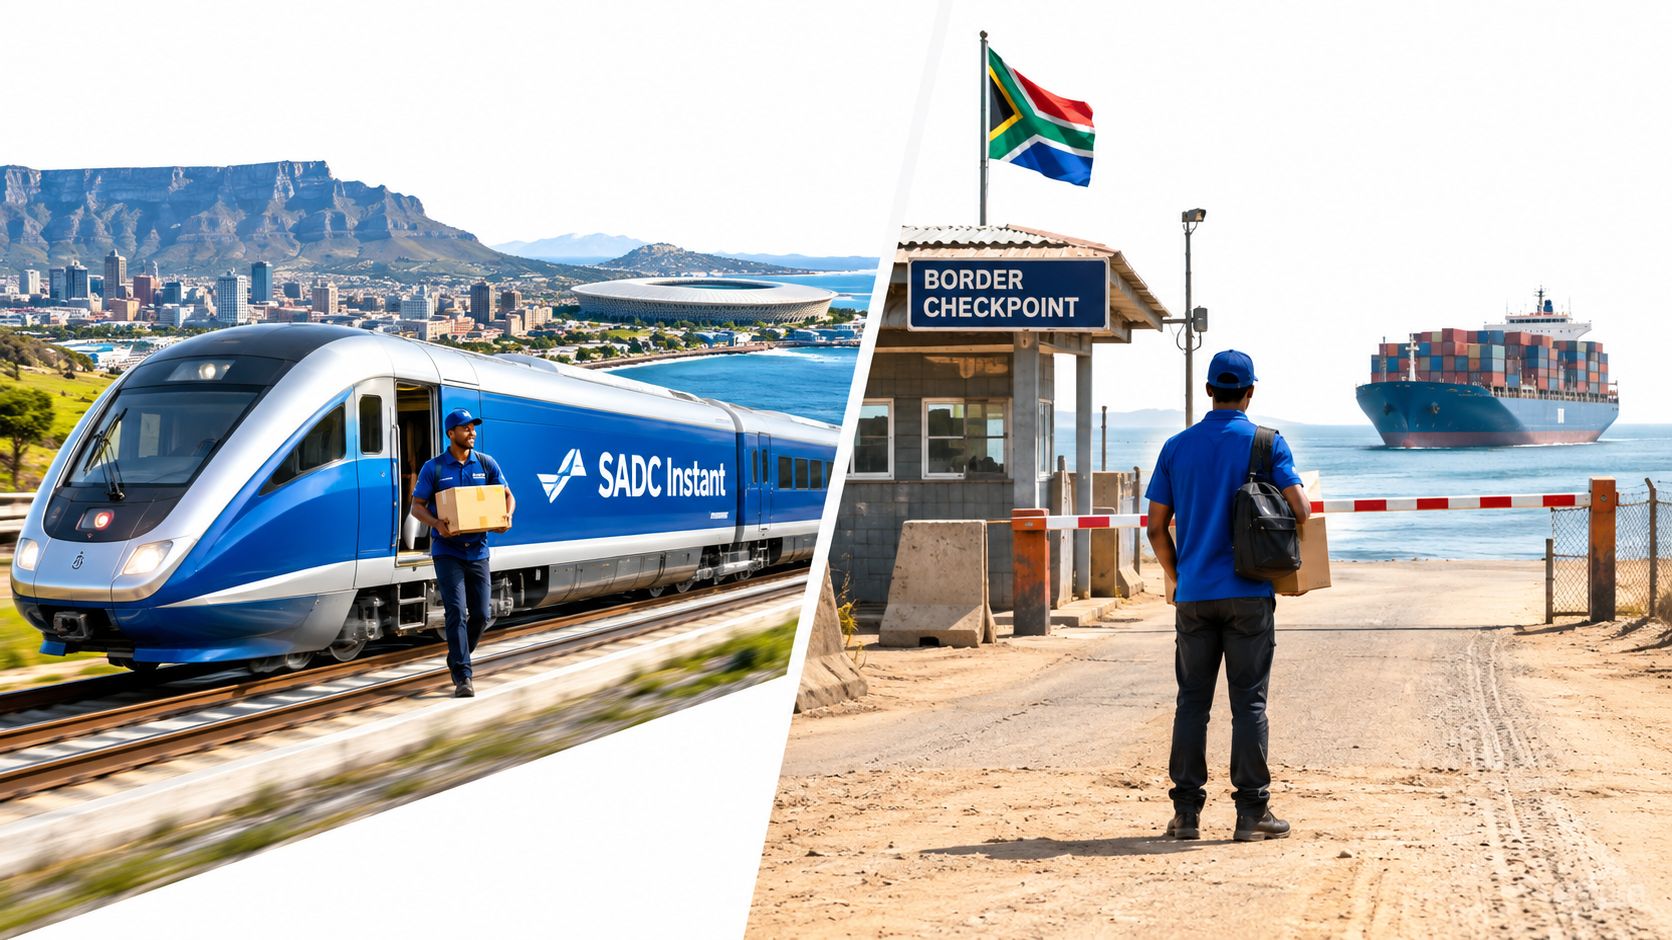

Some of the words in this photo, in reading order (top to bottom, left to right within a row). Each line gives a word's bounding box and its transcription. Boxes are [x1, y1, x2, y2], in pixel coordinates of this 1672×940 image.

[924, 269, 1024, 290] BORDER
[923, 296, 1080, 318] CHECKPOINT
[598, 451, 662, 499] SADC
[666, 456, 726, 497] Instant
